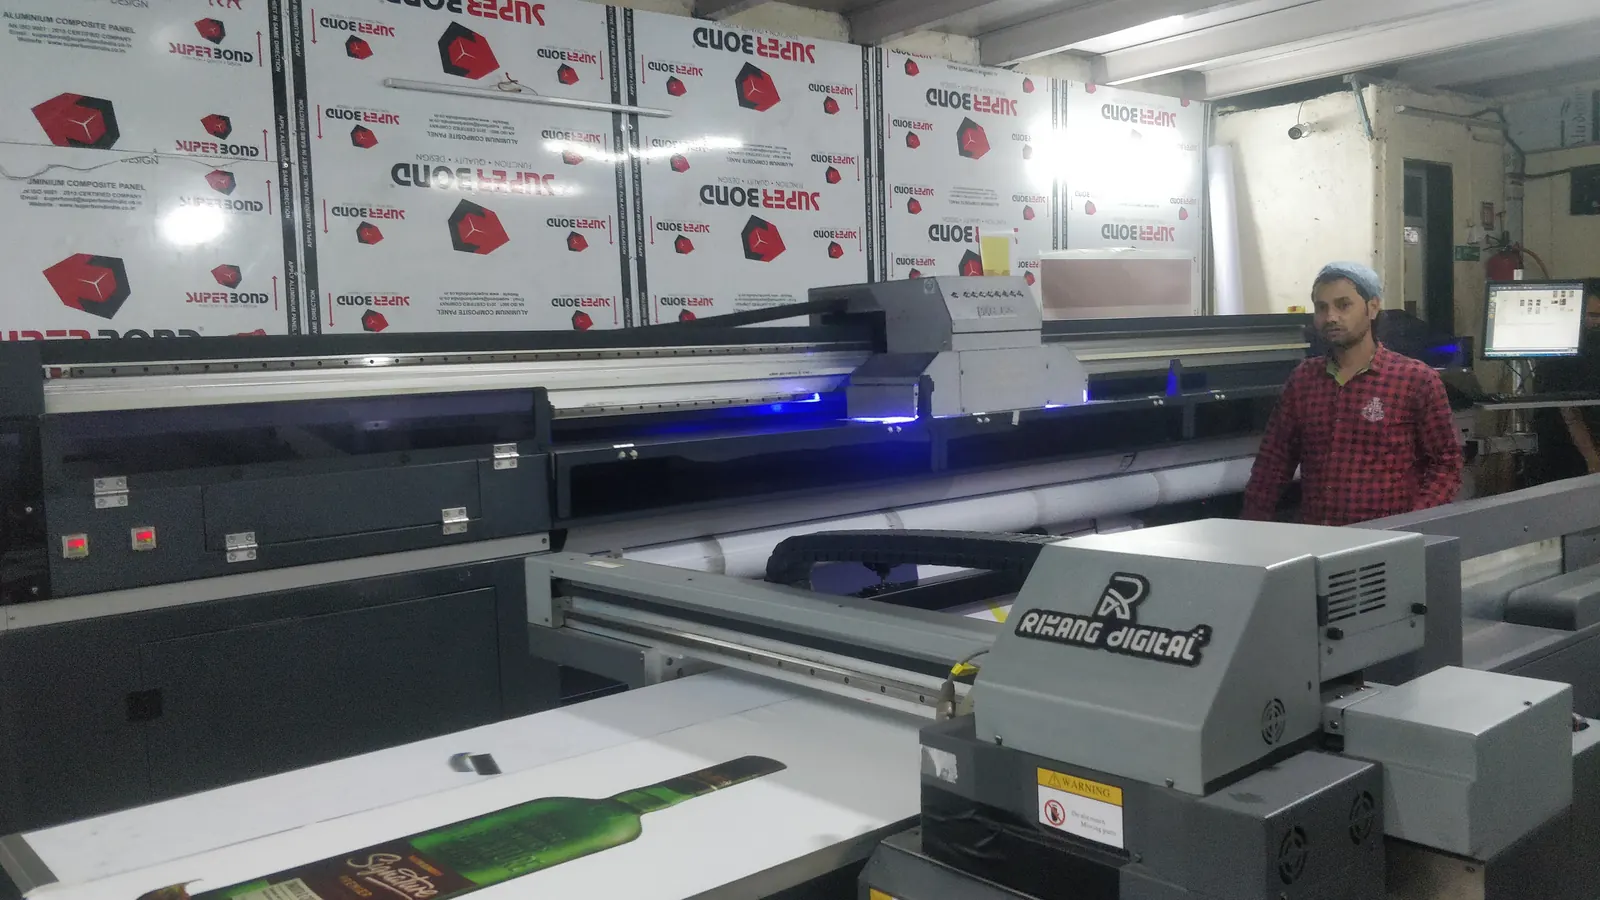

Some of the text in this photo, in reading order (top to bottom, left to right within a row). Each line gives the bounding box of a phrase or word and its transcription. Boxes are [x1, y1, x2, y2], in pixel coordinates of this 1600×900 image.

[3, 11, 137, 34] ALUMINIUM COMPOSITE PANEL
[427, 131, 519, 145] ALUMINIUM COMPOSITE PANEL
[416, 153, 533, 170] FUNCTION QUALITY DESIGN
[66, 180, 117, 190] COMPOSITE
[118, 182, 147, 191] PANEL
[1019, 612, 1104, 645] RIKANG
[1061, 777, 1111, 798] WARNING
[346, 852, 440, 898] Signature
